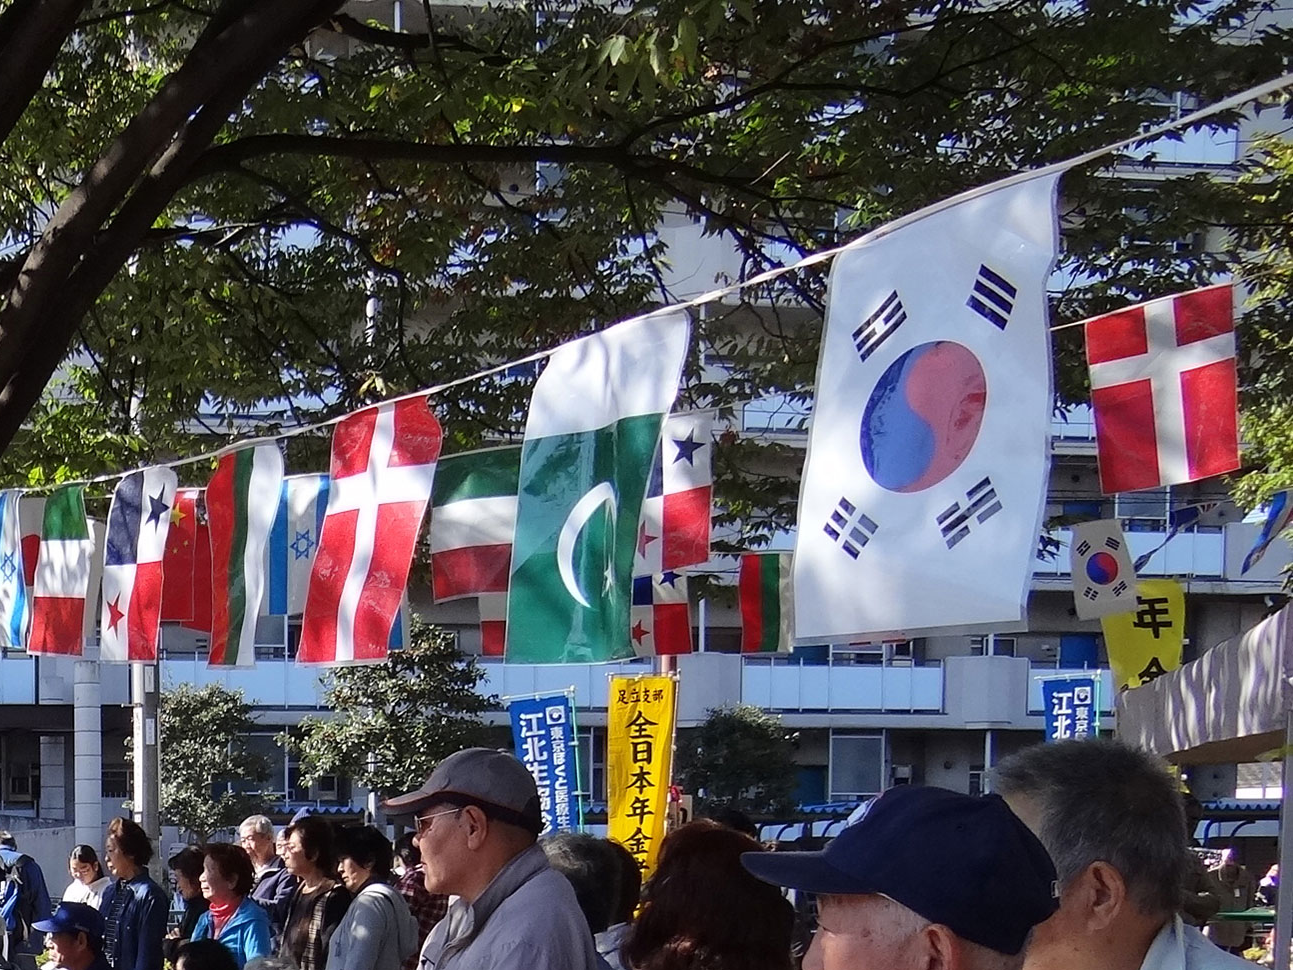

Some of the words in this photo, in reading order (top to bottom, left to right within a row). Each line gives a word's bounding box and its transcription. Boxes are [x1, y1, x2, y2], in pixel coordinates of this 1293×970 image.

[617, 689, 664, 704] 足立支部
[1051, 692, 1073, 740] 江北
[550, 727, 571, 833] 東京ほくと医療生
